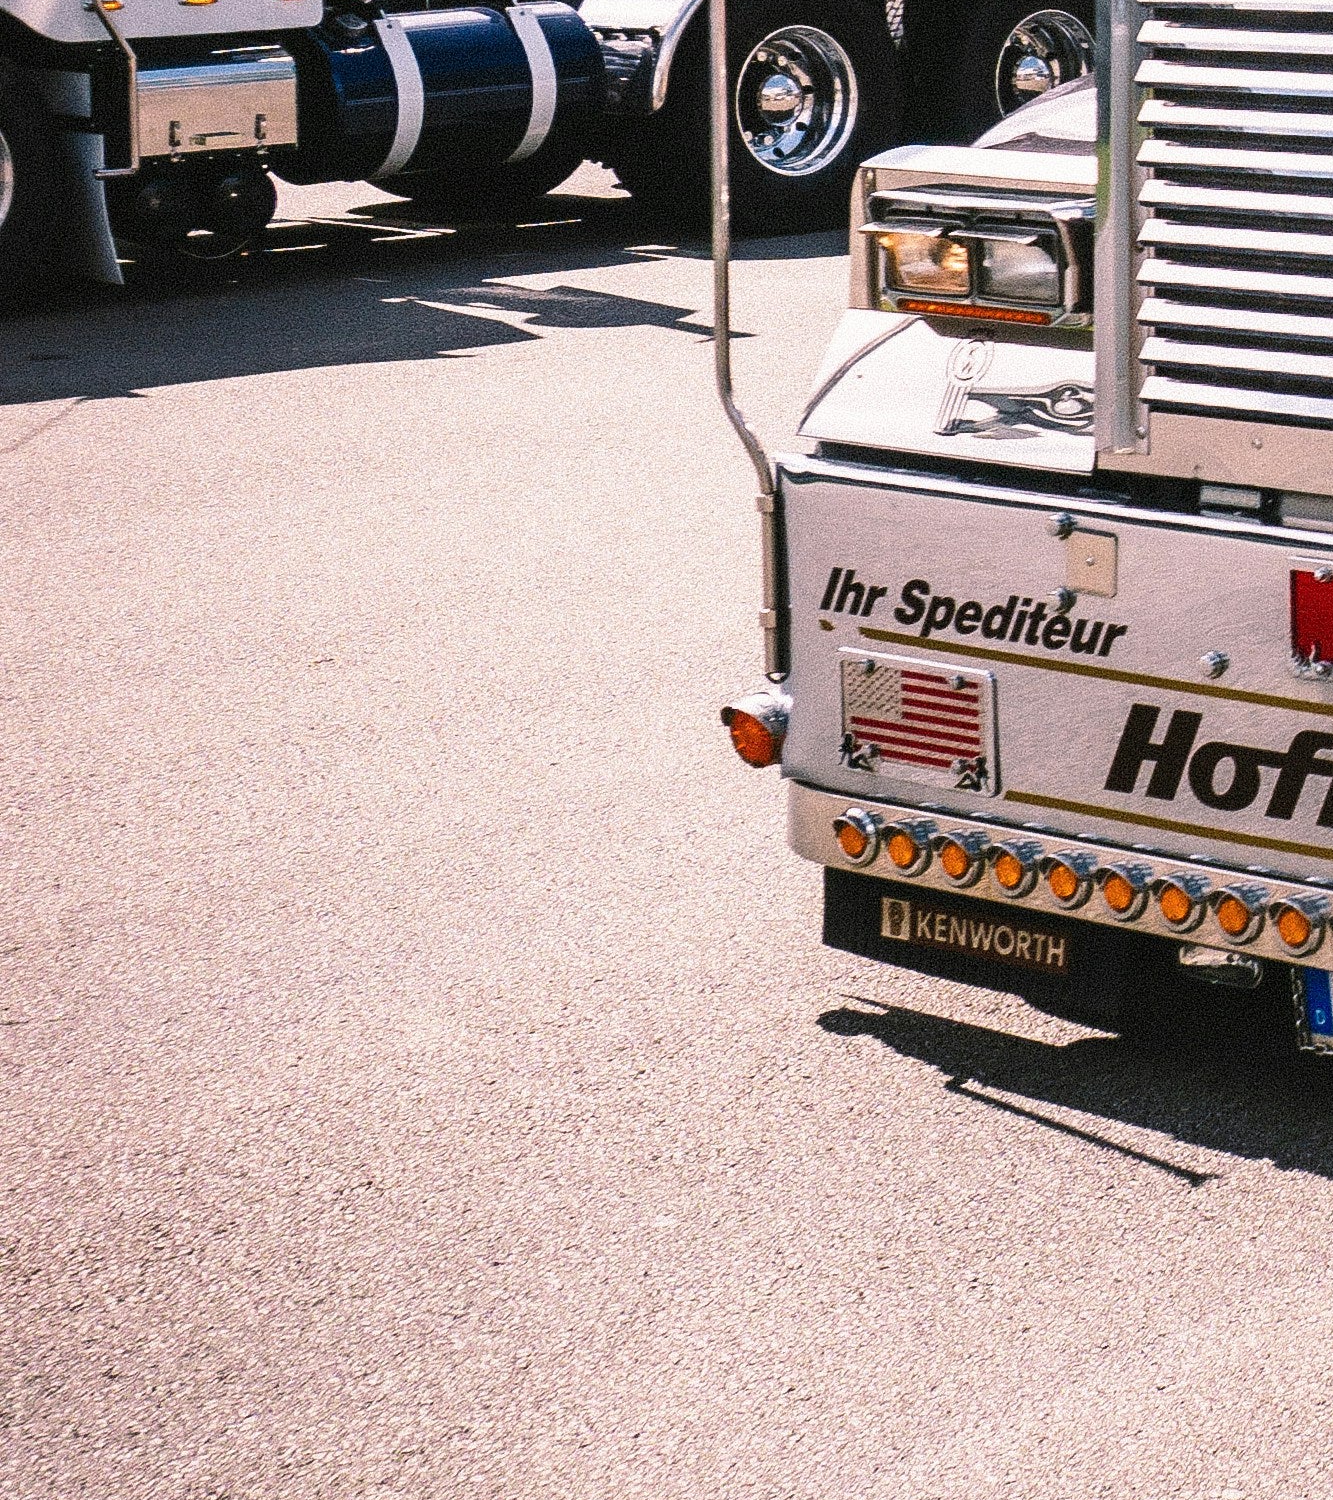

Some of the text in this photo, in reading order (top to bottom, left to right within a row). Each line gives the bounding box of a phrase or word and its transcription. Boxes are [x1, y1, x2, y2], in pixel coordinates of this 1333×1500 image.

[818, 565, 1128, 659] Ihr Spediteur
[915, 908, 1068, 968] KENWORTH
